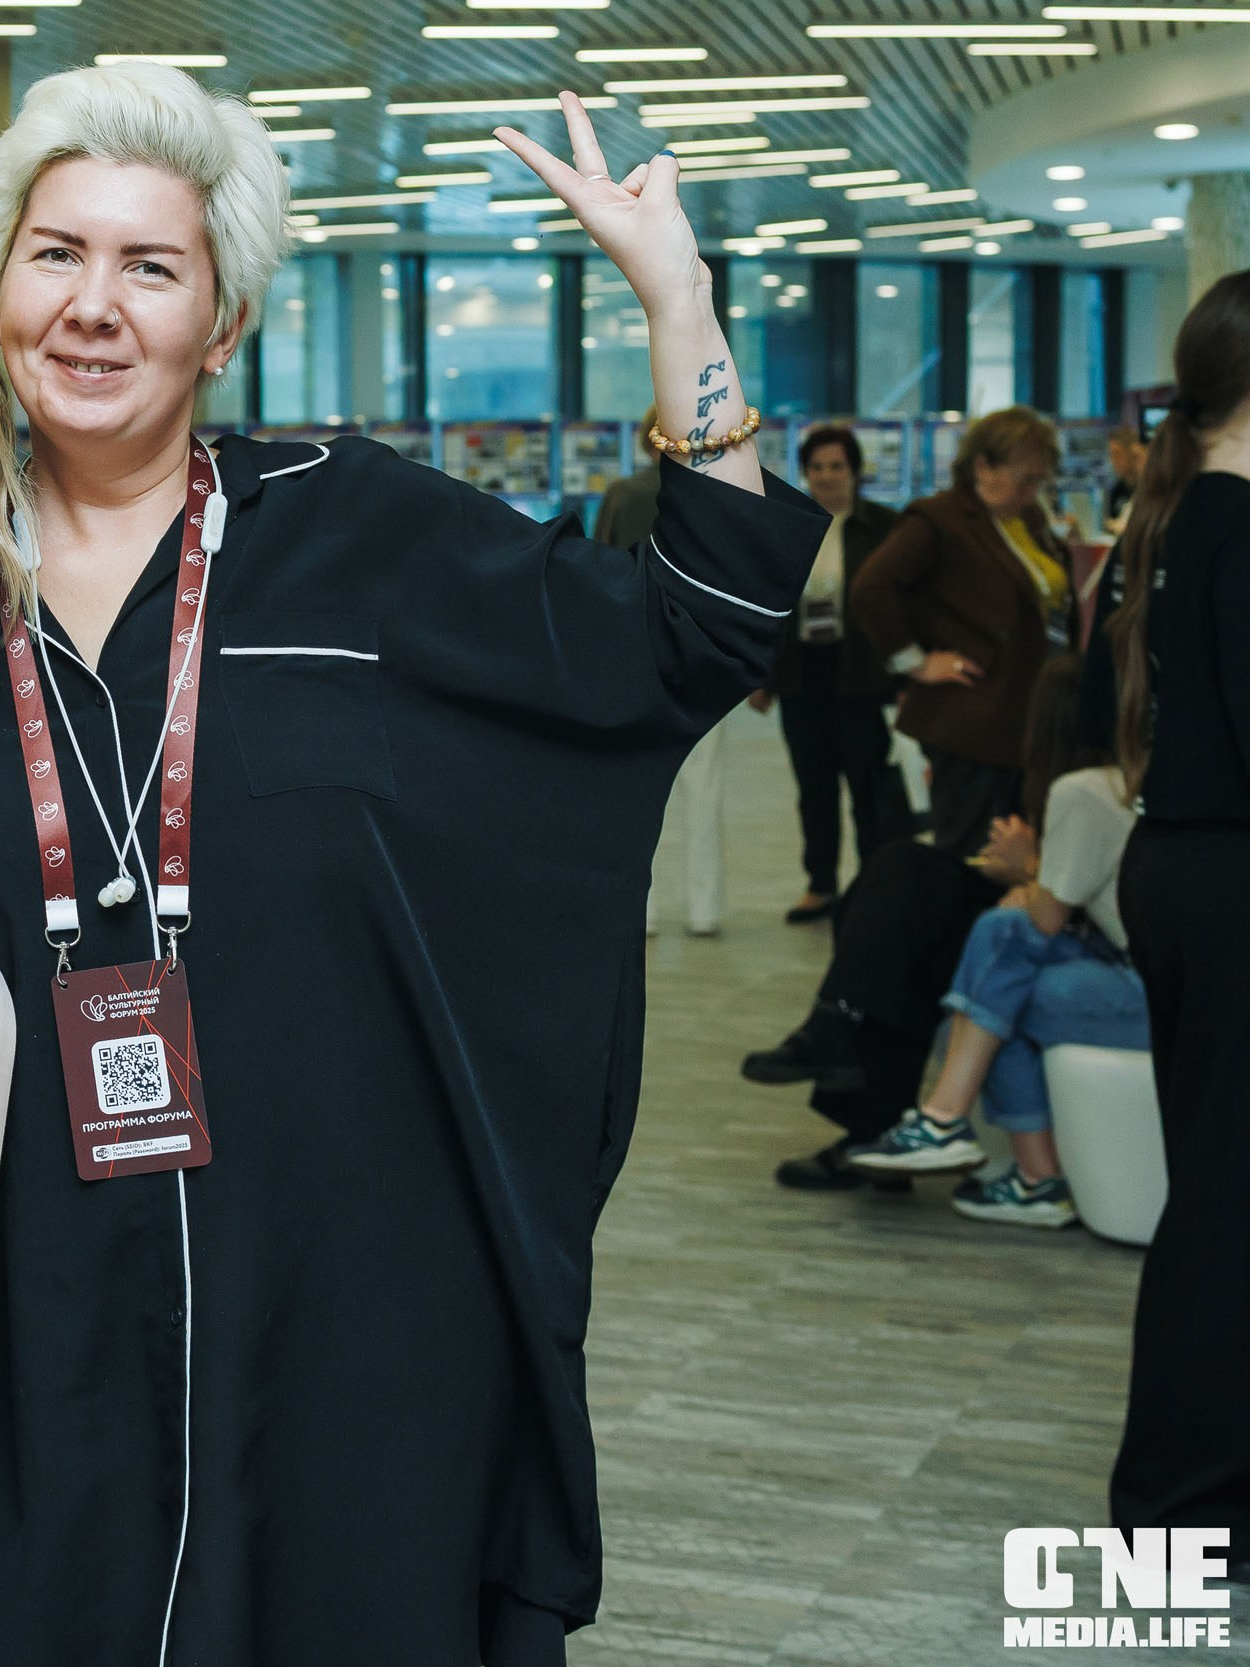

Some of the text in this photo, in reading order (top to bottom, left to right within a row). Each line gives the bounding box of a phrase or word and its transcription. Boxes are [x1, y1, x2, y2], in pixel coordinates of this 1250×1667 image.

[108, 987, 160, 1001] БАЛТИЙСКИЙ
[109, 996, 159, 1010] КУЛЬТУРНЫЙ
[110, 1006, 156, 1019] ФОРУМ 2025
[82, 1110, 193, 1132] ПРОГРАММА ФОРУМА
